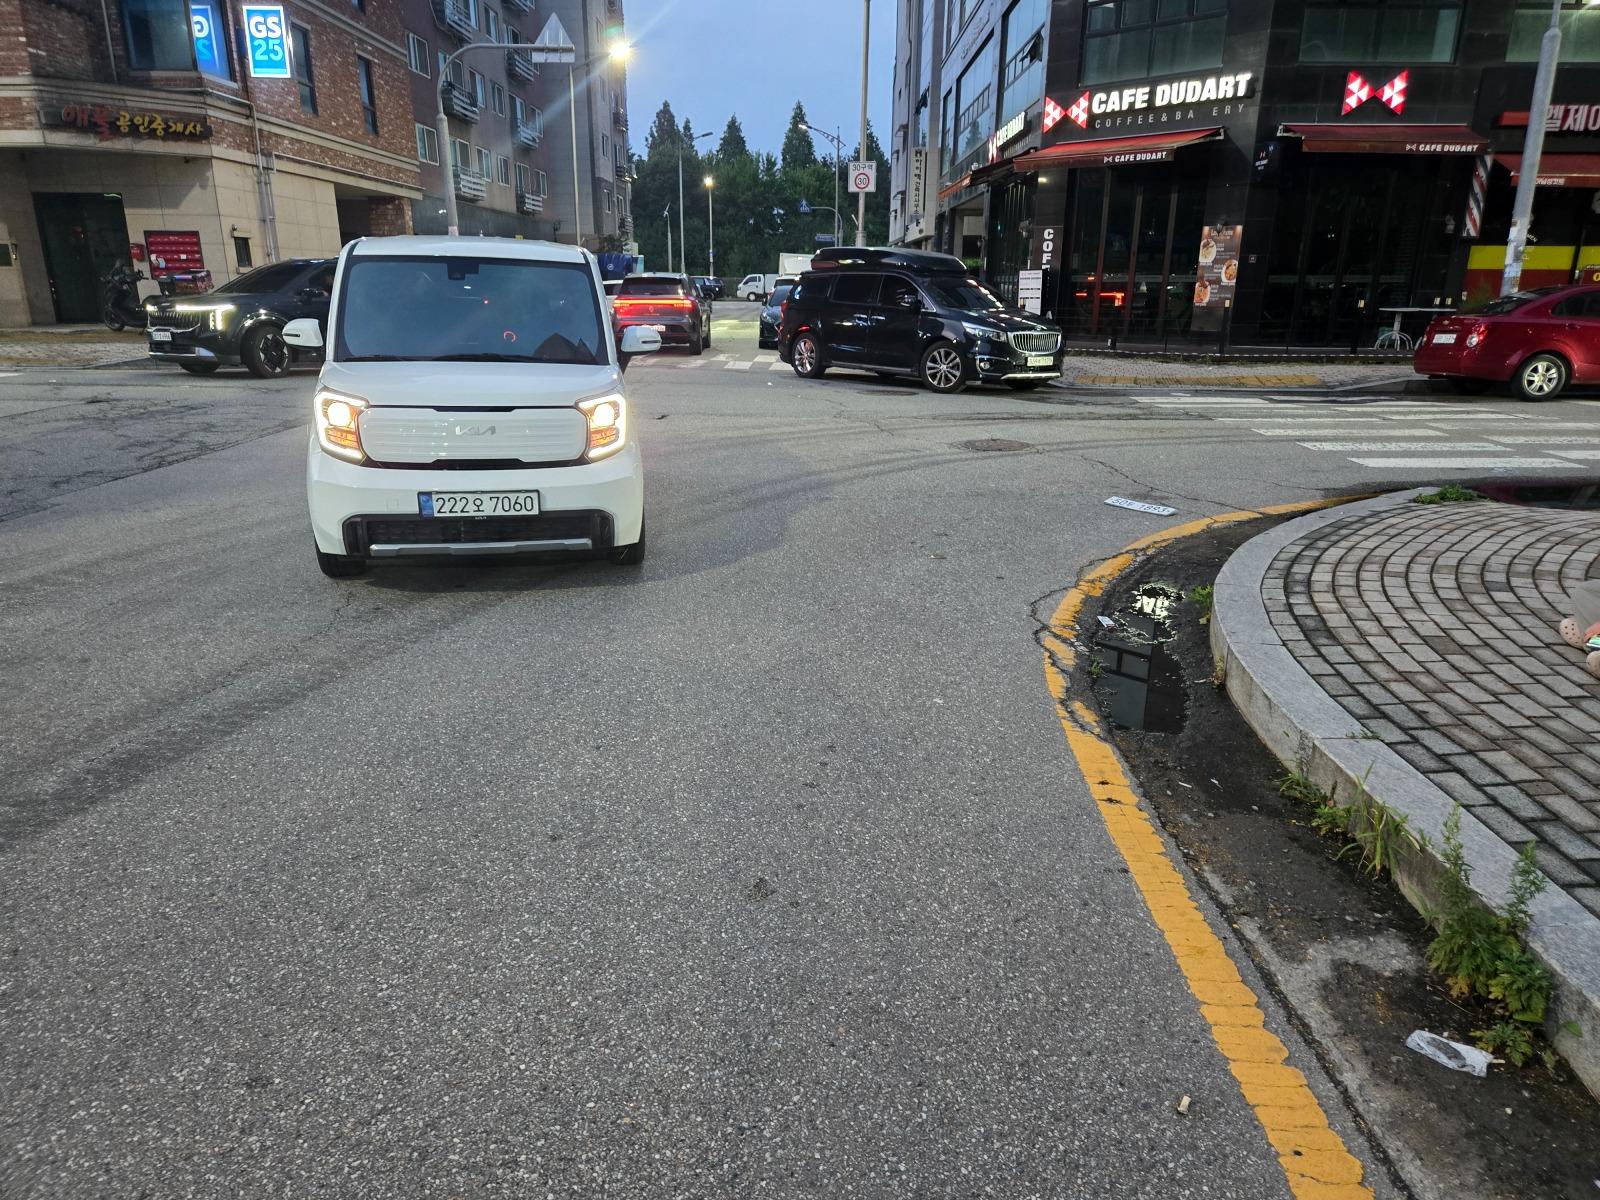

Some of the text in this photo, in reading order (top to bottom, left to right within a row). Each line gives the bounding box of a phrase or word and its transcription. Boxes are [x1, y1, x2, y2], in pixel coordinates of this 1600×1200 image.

[249, 15, 282, 38] GS
[253, 39, 284, 61] 25
[1092, 72, 1252, 114] CAFE DUDART
[116, 111, 204, 137] 공인중개사
[1419, 143, 1479, 153] CAFE DUDART
[1115, 151, 1167, 163] CAFE DUDART
[852, 163, 874, 172] 30구역
[857, 177, 867, 186] 30
